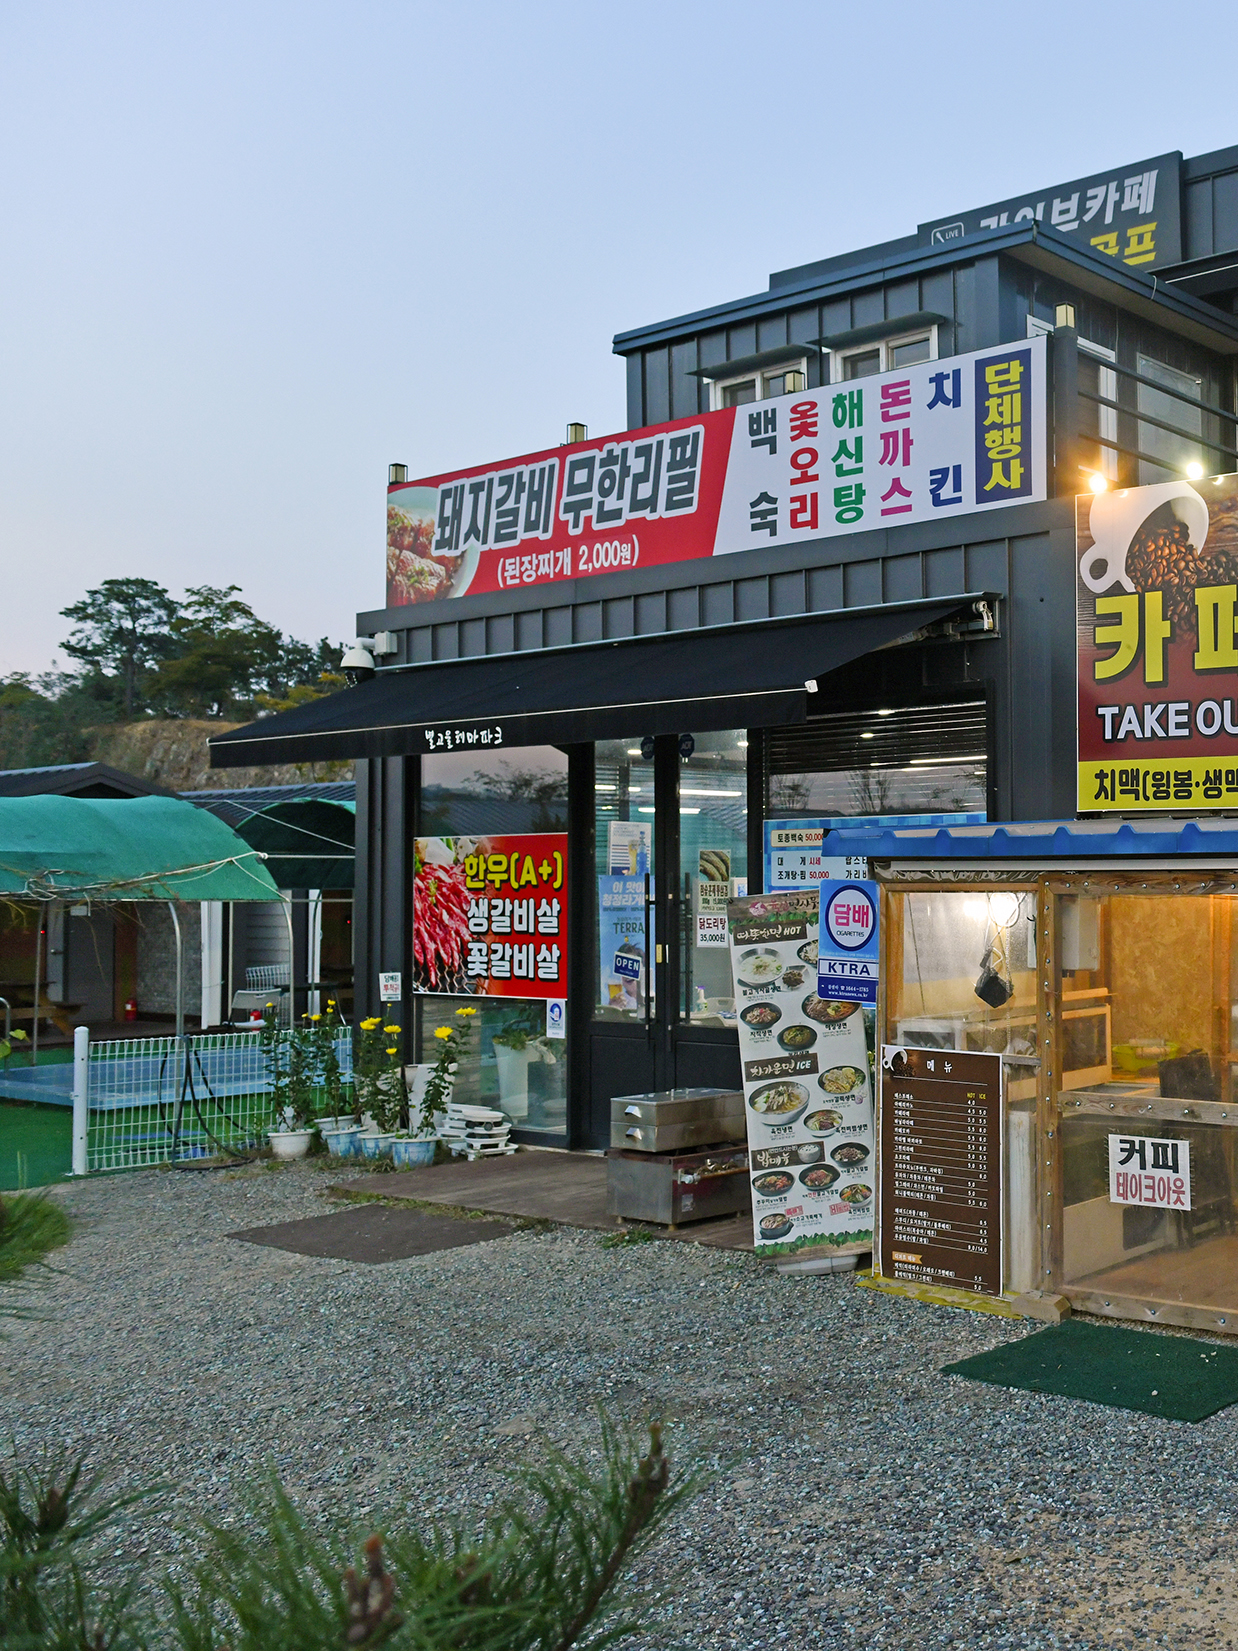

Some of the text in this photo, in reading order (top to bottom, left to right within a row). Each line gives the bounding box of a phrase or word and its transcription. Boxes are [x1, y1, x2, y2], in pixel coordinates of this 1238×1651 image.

[945, 230, 959, 240] LIVE
[983, 359, 1024, 492] 단체행사
[831, 389, 866, 524] 해신탕
[879, 379, 914, 517] 돈까스
[433, 428, 703, 553] 돼지갈비 무한리필
[497, 534, 640, 588] (된장찌개 2,000원)
[1097, 702, 1190, 740] TAKE
[777, 833, 823, 843] 토종백숙 50,00
[463, 850, 564, 890] 한우(A+)
[809, 871, 830, 880] 50,000
[612, 881, 623, 894] 이
[467, 897, 562, 935] 생갈비살
[699, 917, 727, 931] 닭도리탕
[833, 903, 870, 928] 담배
[613, 922, 645, 935] TERRA
[700, 933, 726, 943] 35,000원
[783, 926, 802, 936] HOT
[466, 941, 562, 981] 꽃갈비살
[616, 957, 640, 971] OPEN
[828, 962, 871, 976] KTRA
[796, 1060, 812, 1070] ICE
[1117, 1138, 1179, 1174] 커피
[1115, 1173, 1187, 1207] 테이크아웃
